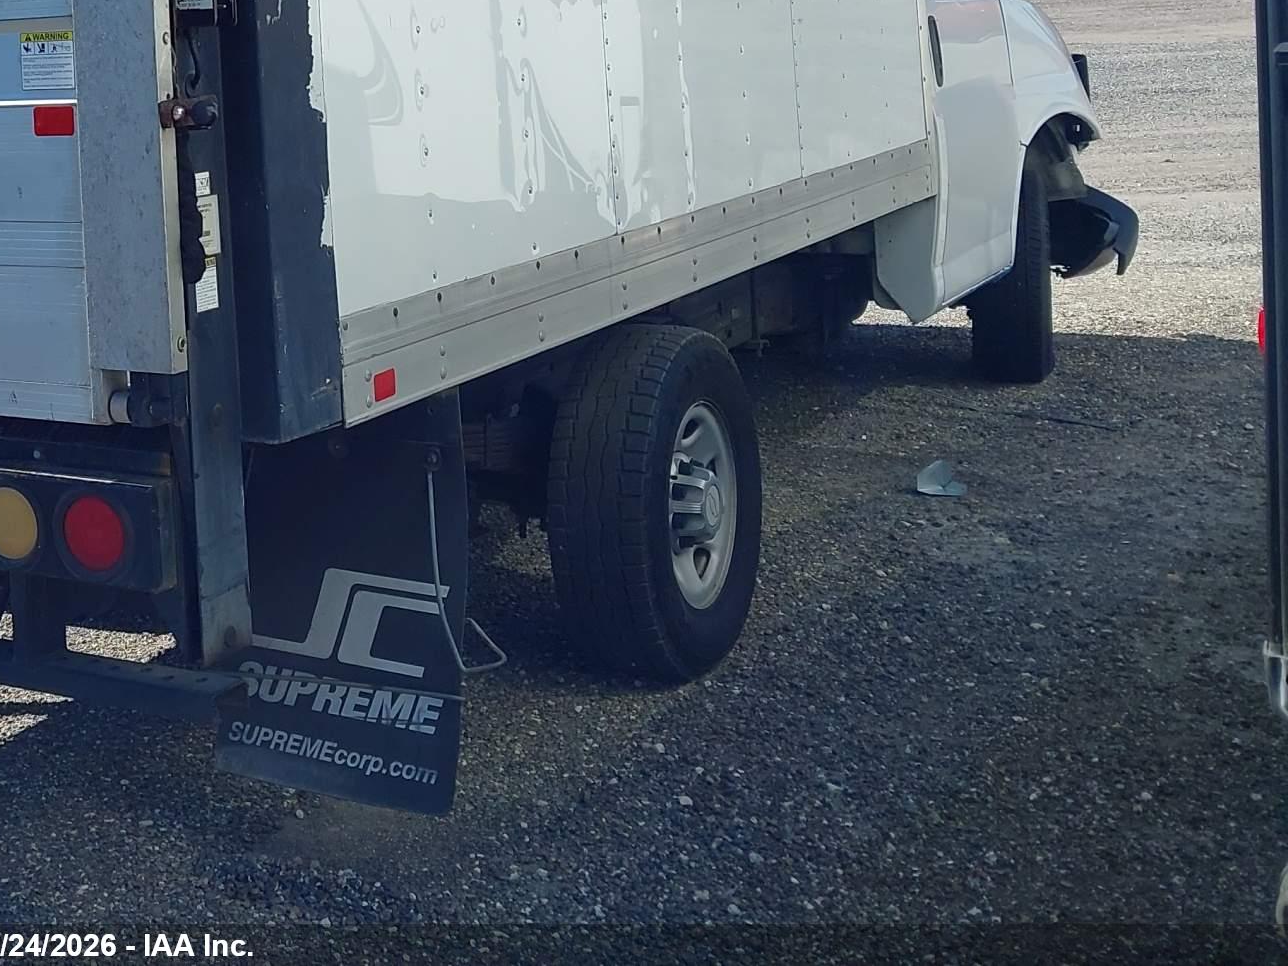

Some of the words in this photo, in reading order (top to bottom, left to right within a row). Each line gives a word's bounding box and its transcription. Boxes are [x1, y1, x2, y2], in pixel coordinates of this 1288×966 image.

[32, 32, 69, 41] WARNING
[238, 660, 444, 736] SUPREME
[227, 720, 439, 786] SUPREMEcorp.com
